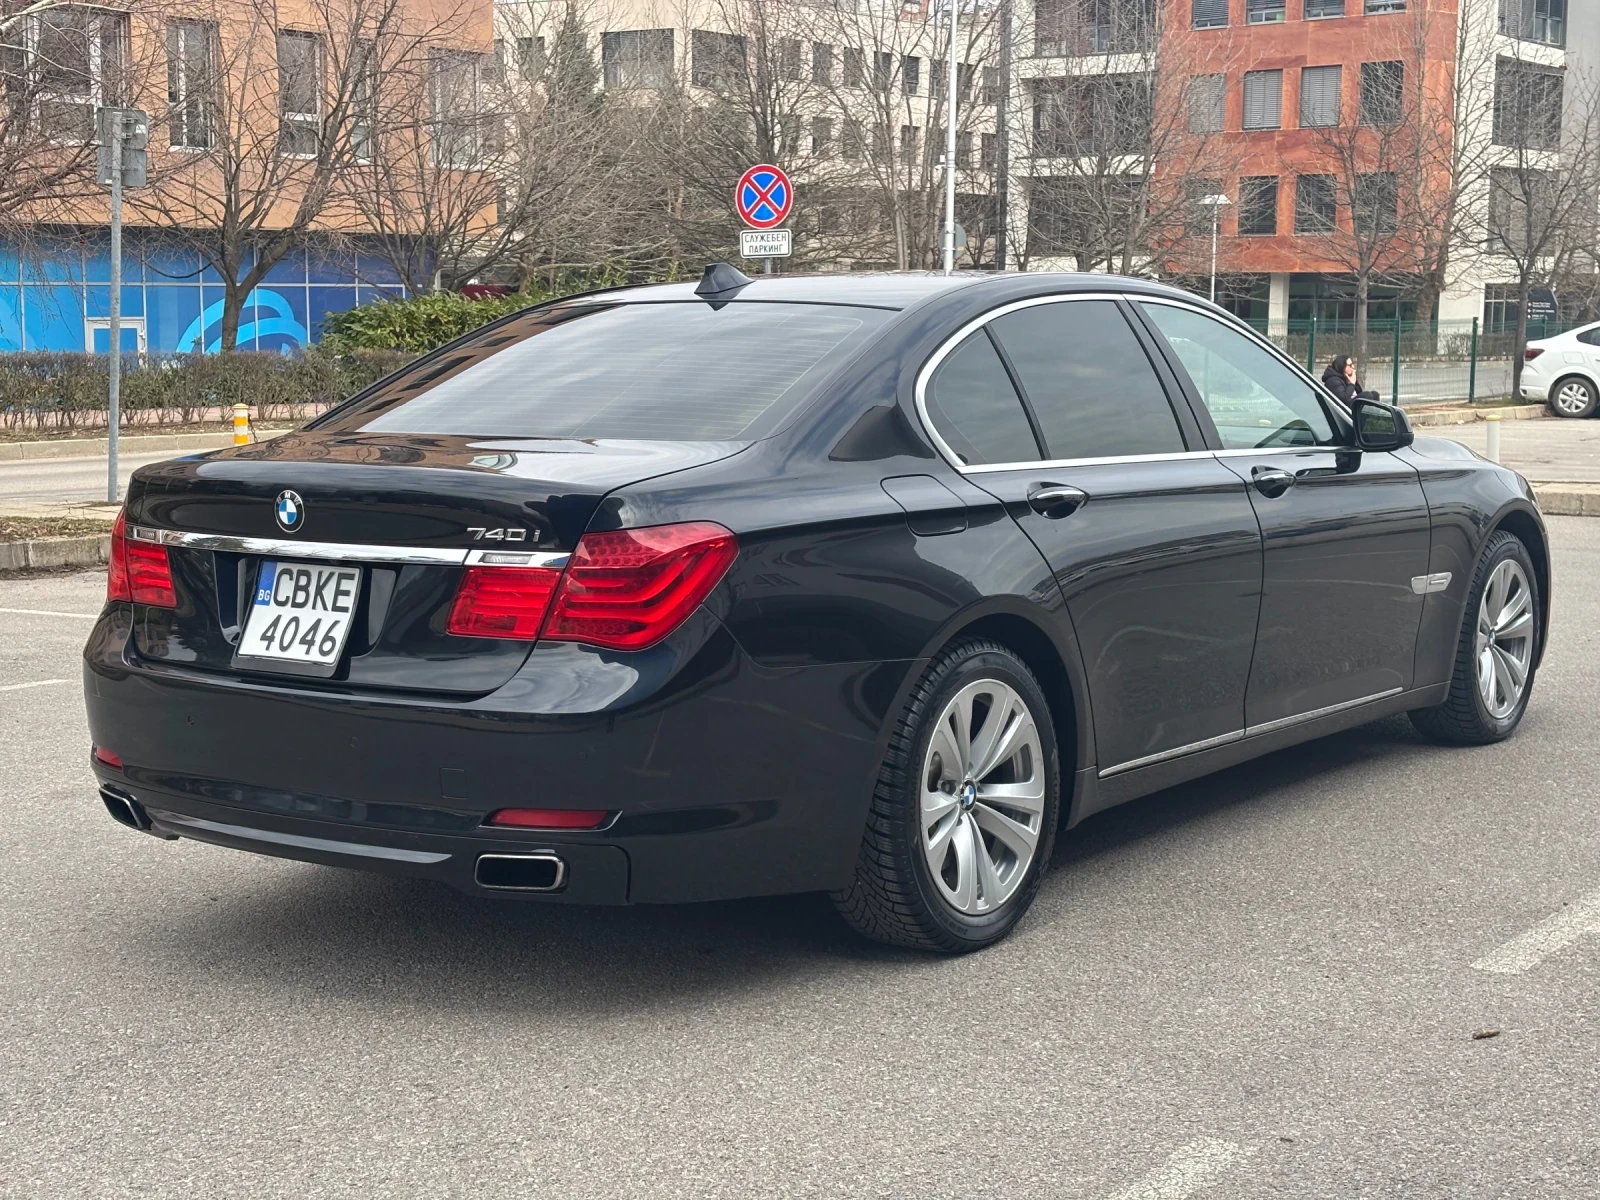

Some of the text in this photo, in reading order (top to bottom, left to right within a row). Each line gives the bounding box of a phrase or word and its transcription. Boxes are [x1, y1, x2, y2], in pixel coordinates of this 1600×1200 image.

[744, 233, 787, 243] СЛУЖЕБЕН
[748, 244, 783, 254] ПАРКИНГ
[257, 589, 271, 601] BG
[273, 568, 356, 613] CBKE
[259, 614, 341, 657] 4046
[1048, 770, 1059, 835] KUMHO
